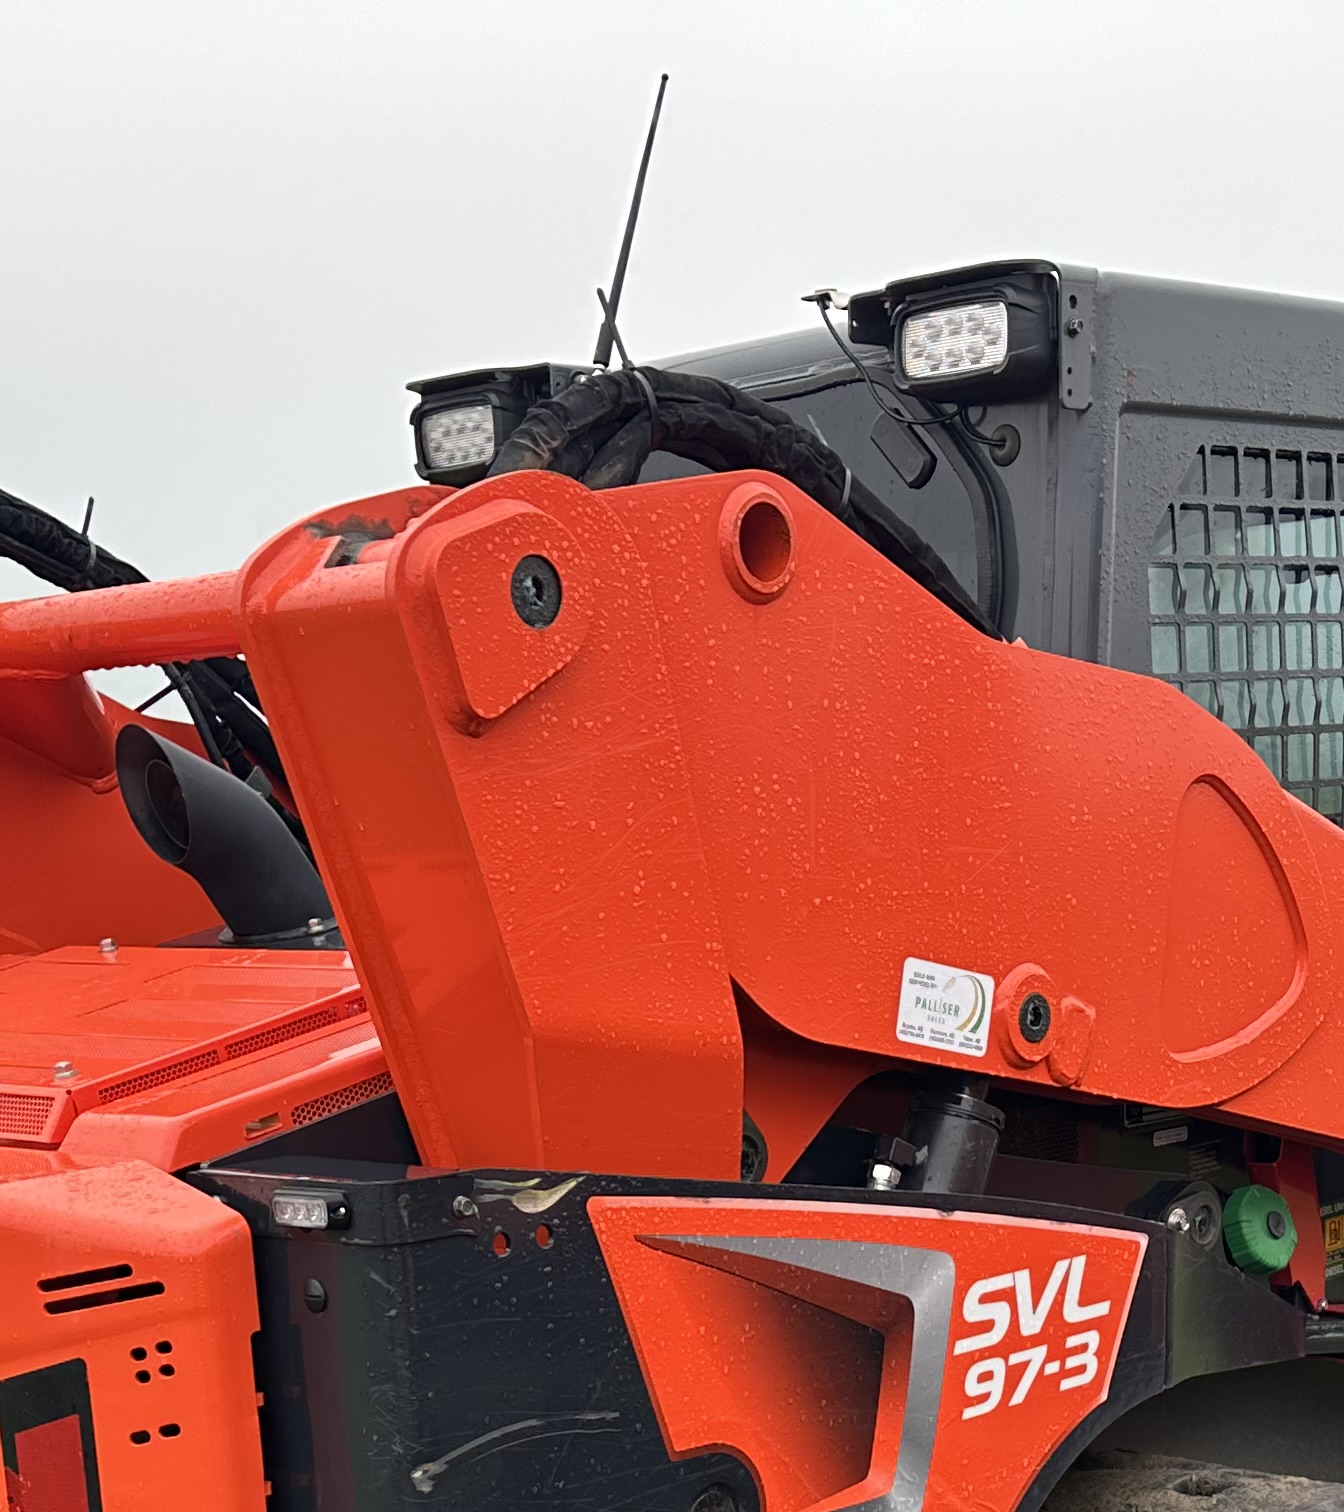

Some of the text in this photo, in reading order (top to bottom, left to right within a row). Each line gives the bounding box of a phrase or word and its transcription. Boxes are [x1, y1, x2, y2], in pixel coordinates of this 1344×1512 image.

[915, 996, 960, 1017] PALLISER
[953, 1254, 1111, 1356] SVL
[961, 1329, 1100, 1421] 97-3
